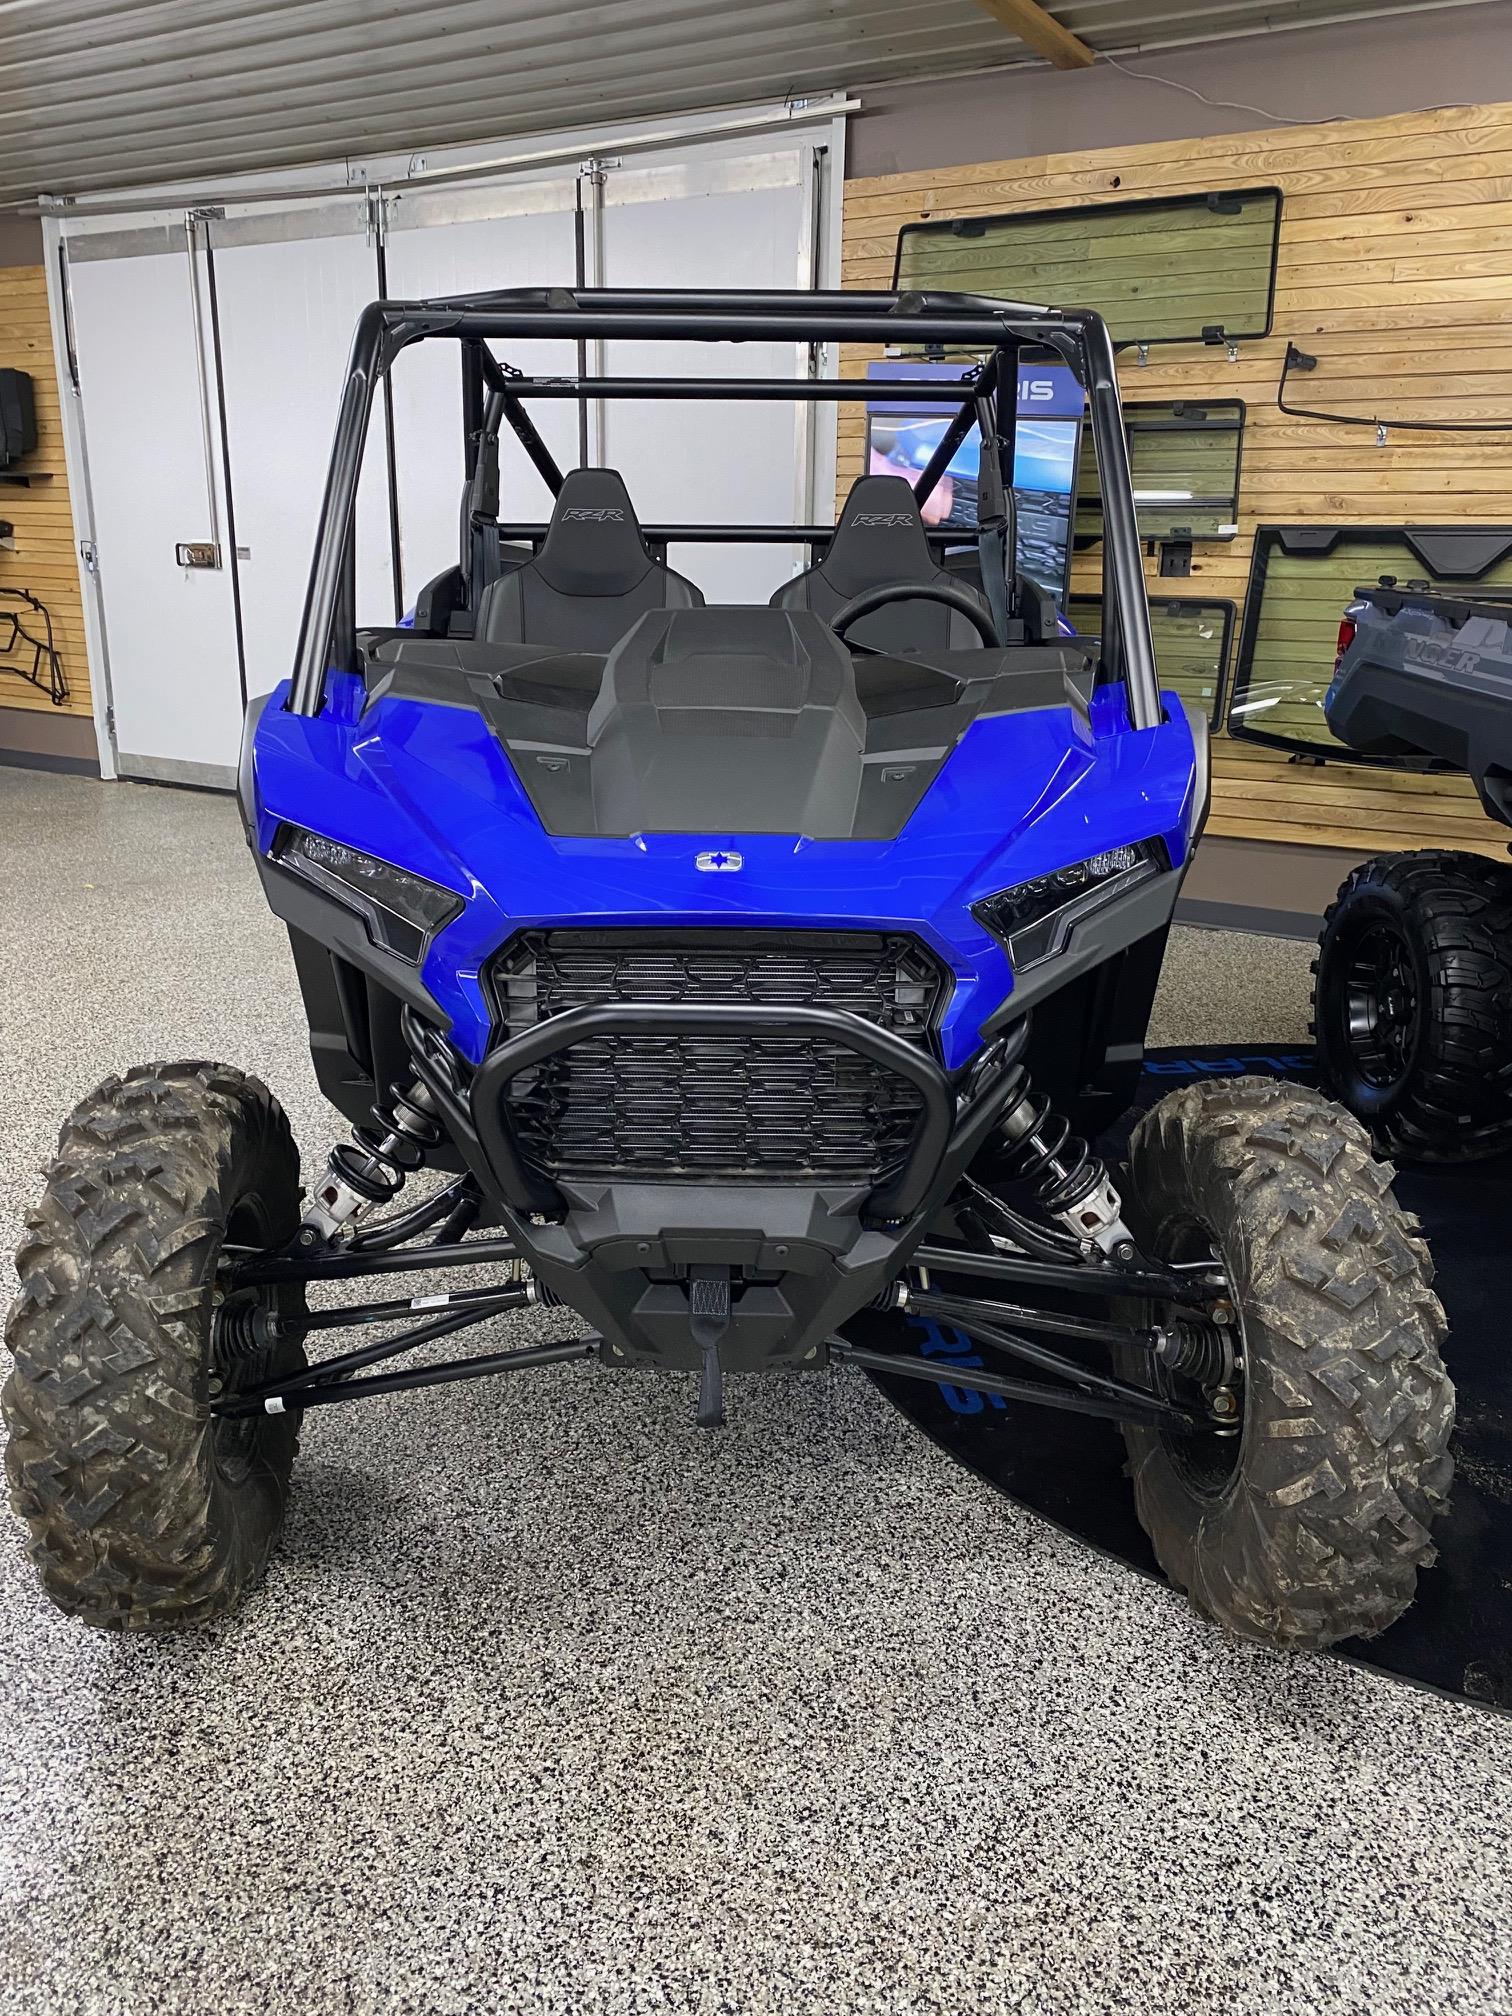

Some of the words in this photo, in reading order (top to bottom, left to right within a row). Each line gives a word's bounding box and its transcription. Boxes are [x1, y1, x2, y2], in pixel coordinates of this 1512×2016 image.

[1018, 380, 1054, 400] IS
[561, 507, 624, 521] RZR
[851, 513, 913, 526] RZR
